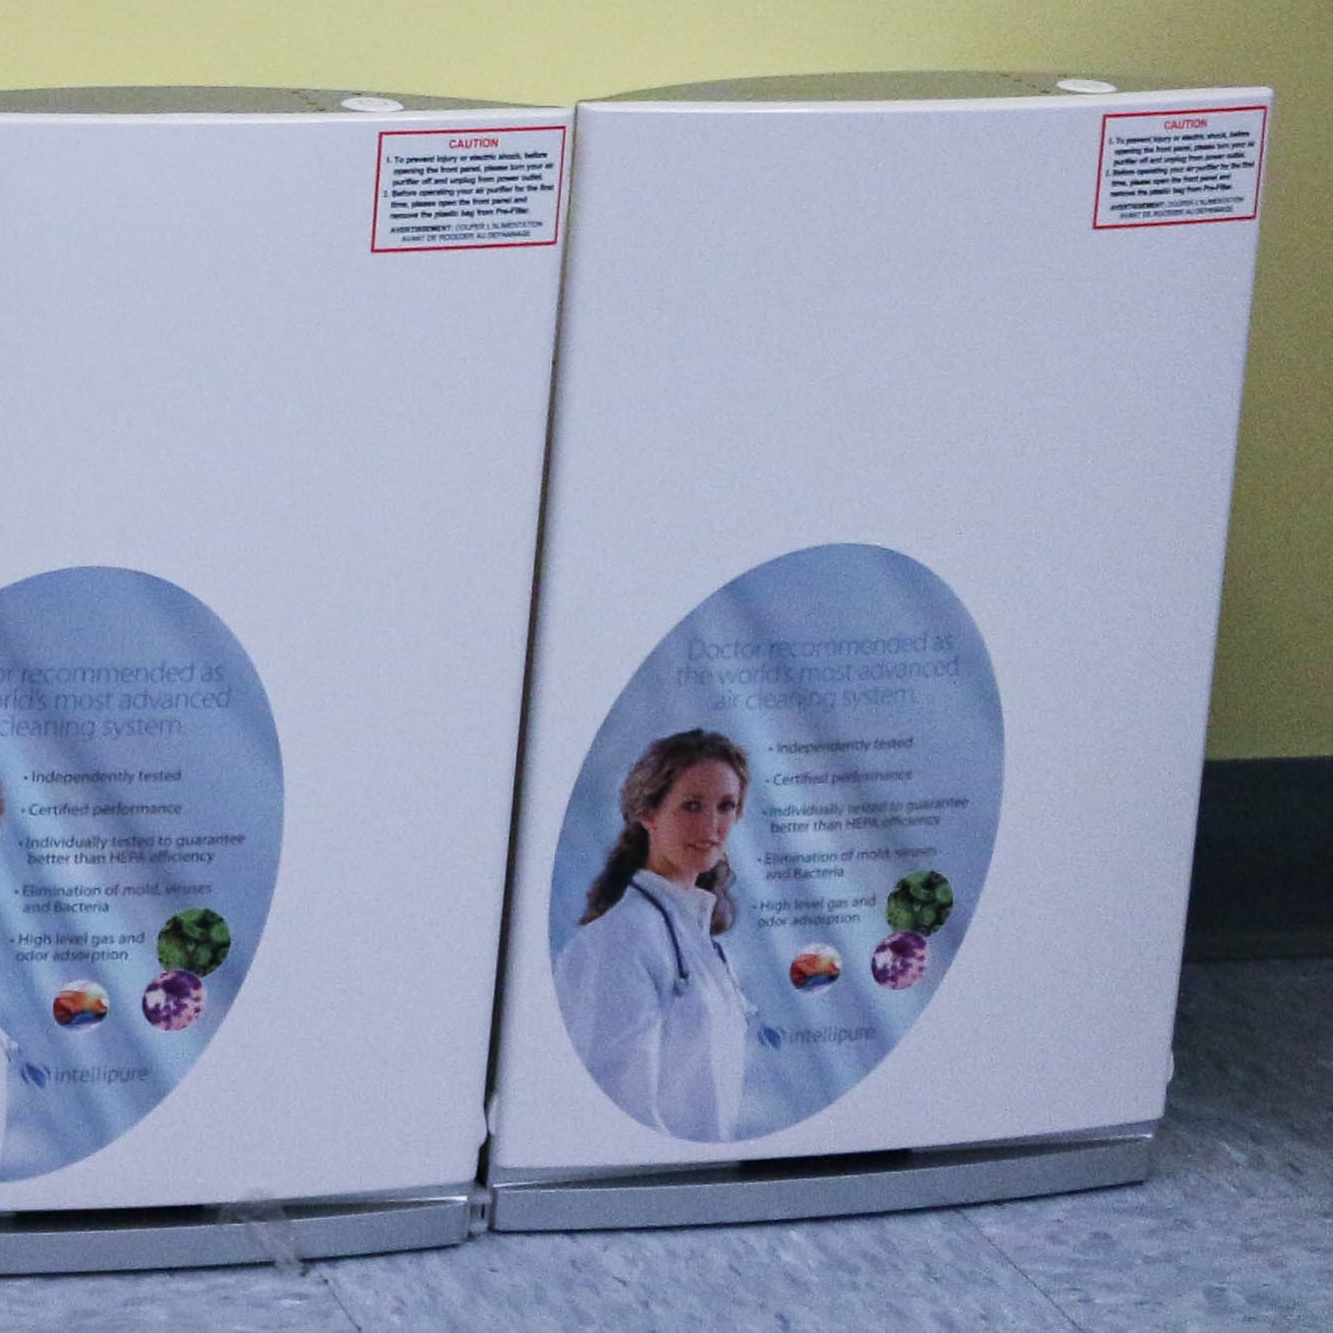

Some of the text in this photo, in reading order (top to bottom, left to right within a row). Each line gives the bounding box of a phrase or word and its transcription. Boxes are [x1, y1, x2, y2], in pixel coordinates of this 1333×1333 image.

[1164, 118, 1207, 130] CAUTION
[449, 138, 499, 149] CAUTION
[20, 663, 194, 685] recommended
[200, 666, 224, 683] as
[54, 690, 114, 711] most
[119, 687, 231, 711] advanced
[777, 740, 870, 754] Independently
[32, 770, 182, 785] Independently tested
[773, 772, 829, 786] Certified
[28, 803, 183, 818] Certified performance
[770, 819, 842, 834] better than
[26, 835, 108, 850] Individually
[158, 835, 173, 847] to
[176, 832, 246, 847] guarantee
[27, 852, 70, 865] better
[74, 852, 107, 864] than
[149, 850, 215, 865] efficiency
[764, 849, 855, 865] Elimination of
[793, 867, 845, 880] Bacteria
[22, 883, 101, 897] Elimination
[104, 883, 119, 896] of
[23, 900, 109, 914] and Bacteria
[760, 894, 877, 913] High level gas and
[757, 916, 788, 928] odor
[18, 931, 145, 947] High level gas and
[16, 948, 128, 963] odor adsorption
